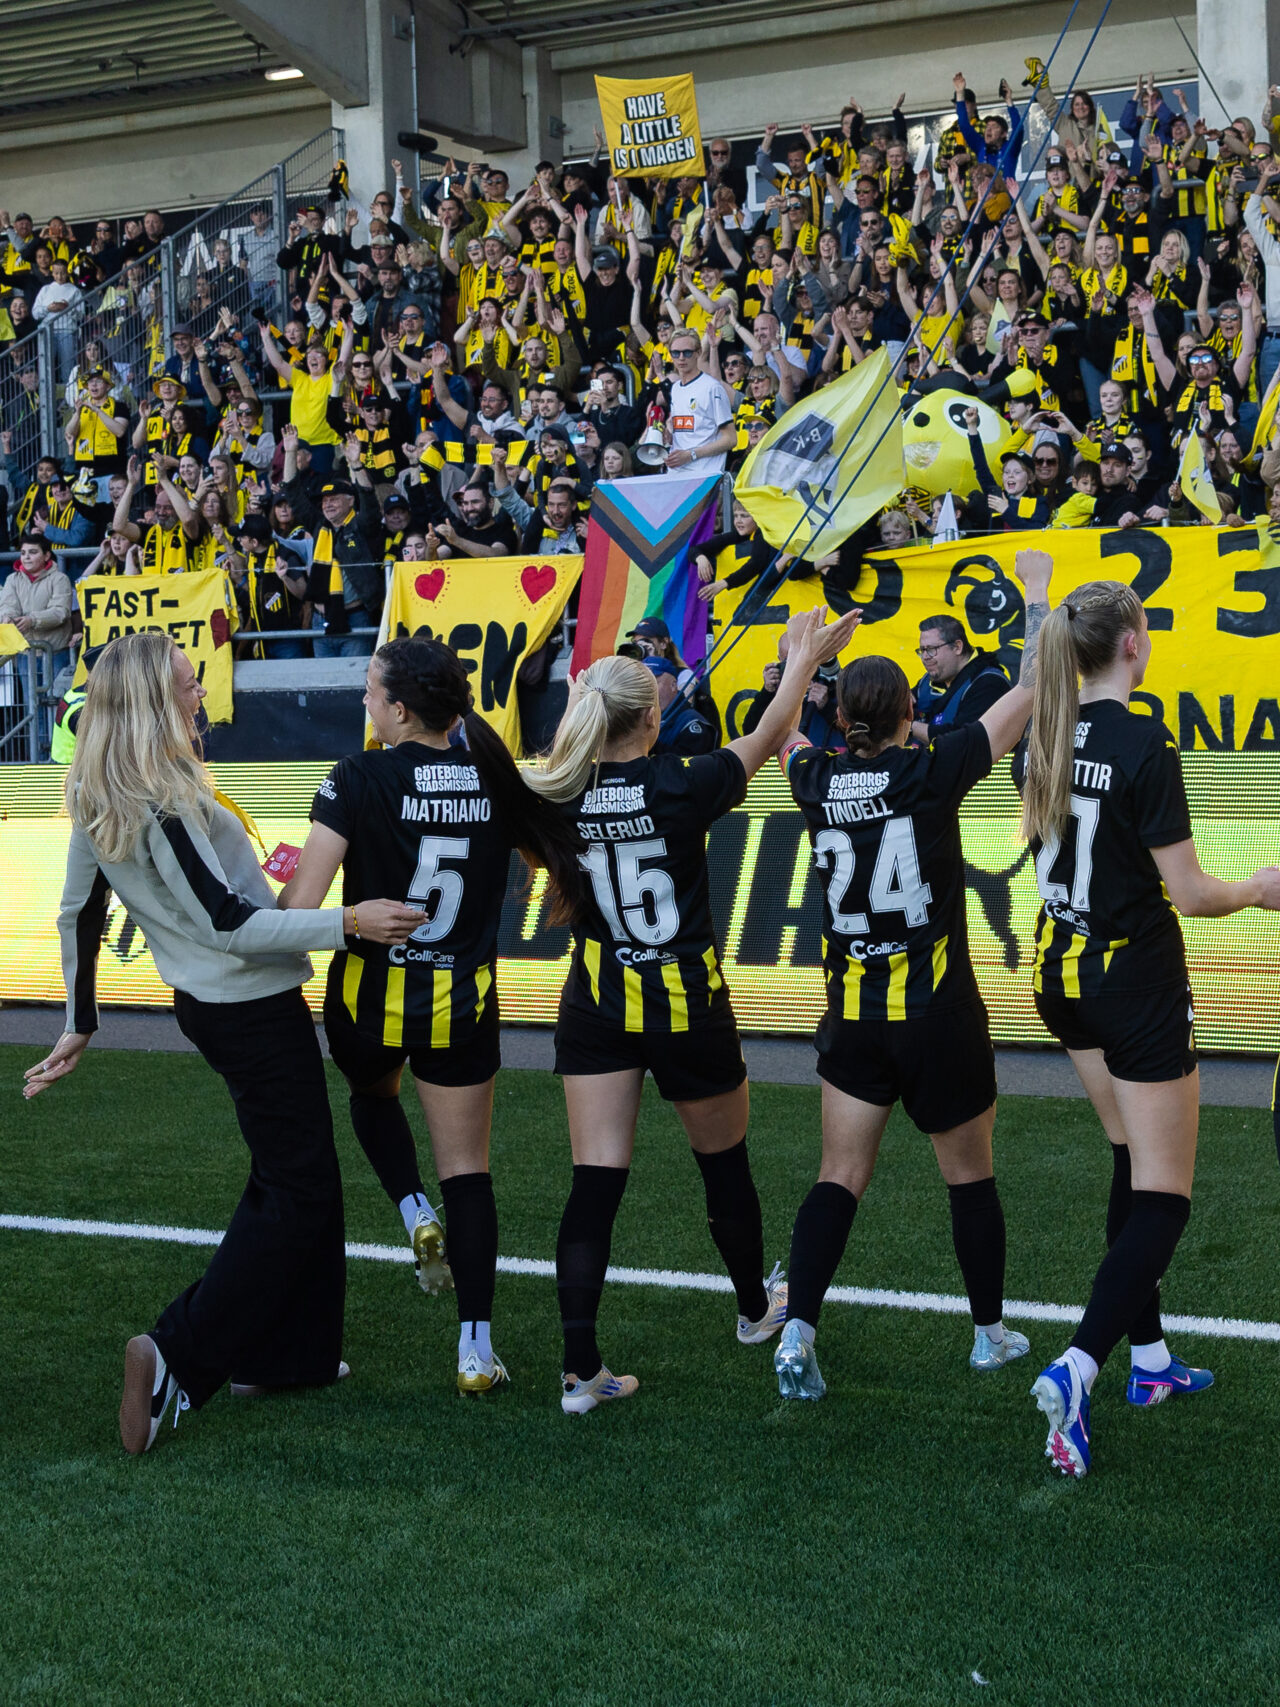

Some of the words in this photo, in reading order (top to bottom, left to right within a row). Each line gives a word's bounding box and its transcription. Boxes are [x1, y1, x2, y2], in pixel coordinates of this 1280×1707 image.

[624, 92, 667, 120] HAVE
[621, 123, 632, 146] A
[633, 114, 682, 145] LITTLE
[614, 147, 628, 169] IS
[629, 149, 638, 169] I
[638, 136, 696, 168] MAGEN
[84, 587, 179, 619] FAST-
[84, 620, 206, 650] LAET
[414, 765, 478, 781] GÖTEBORGS
[416, 779, 480, 793] STADSMISSION
[401, 795, 491, 823] MATRIANO
[580, 797, 646, 814] STADSMISSION
[821, 797, 894, 826] TINDELL
[576, 815, 656, 840] SELERUD
[405, 835, 470, 943] 5
[813, 815, 933, 935] 24
[576, 837, 680, 946] 15
[406, 949, 455, 963] ColliCare
